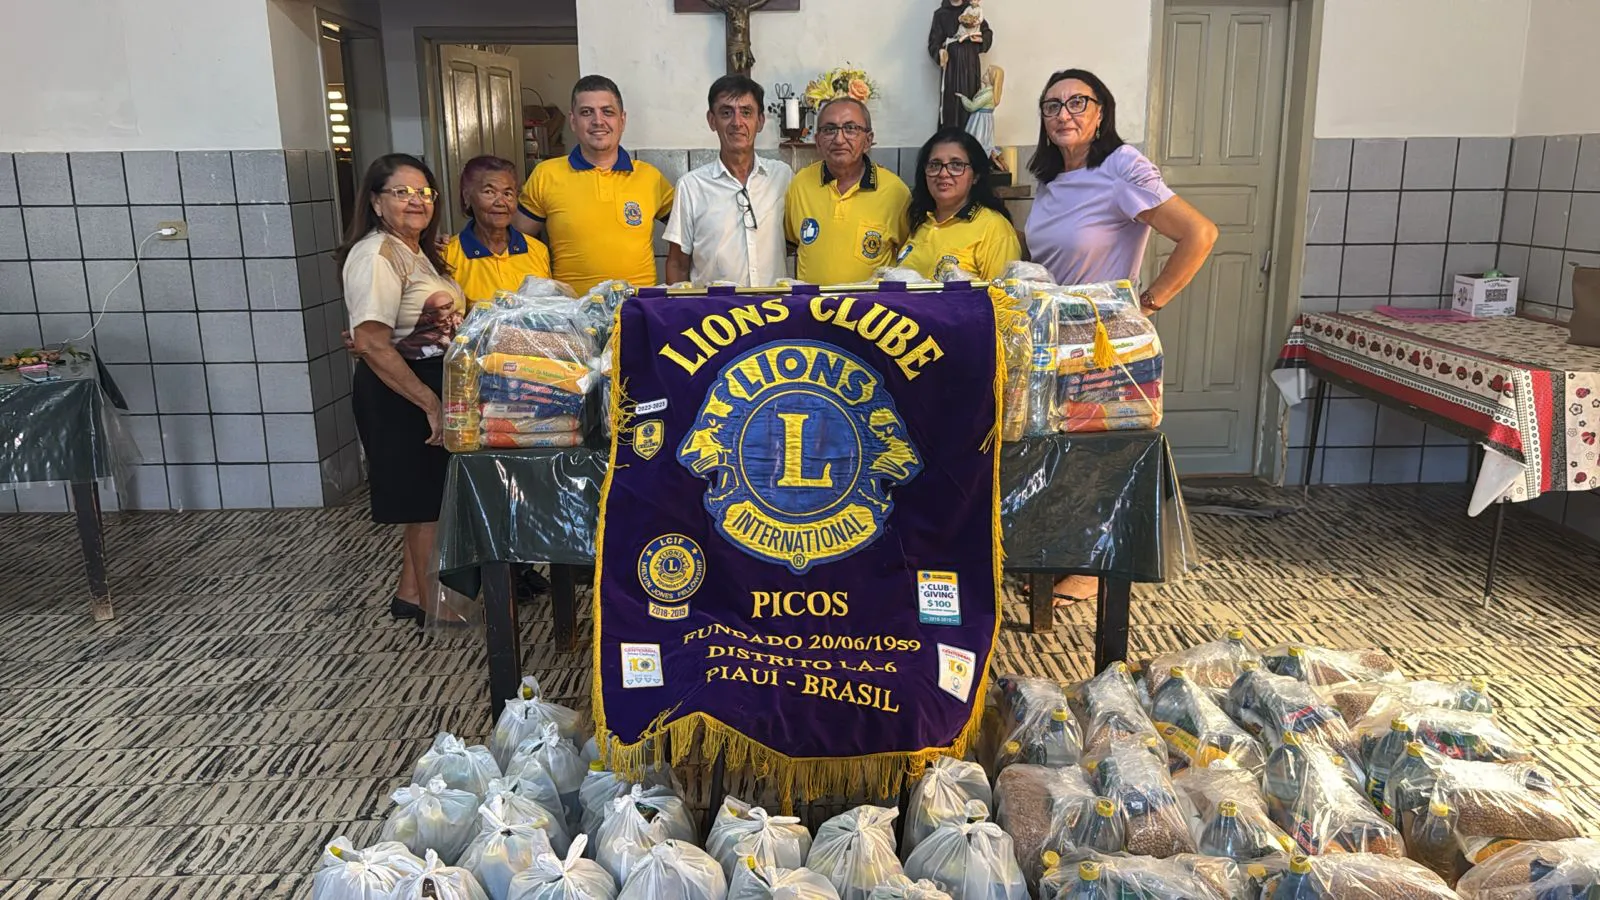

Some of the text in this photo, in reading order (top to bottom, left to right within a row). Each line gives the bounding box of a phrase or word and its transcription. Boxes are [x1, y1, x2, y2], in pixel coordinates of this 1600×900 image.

[658, 296, 945, 381] LIONS CLUBE
[731, 348, 872, 401] LIONS
[777, 413, 833, 487] L
[660, 537, 685, 546] LCIF
[731, 509, 868, 553] INTERNATIONAL
[641, 559, 703, 599] MELVIN JONES FELLOWSHIP
[668, 559, 678, 571] L
[923, 590, 954, 599] GIVING
[927, 583, 950, 591] CLUB
[652, 605, 686, 618] 2018-2019
[750, 591, 849, 618] PICOS
[683, 623, 922, 652] FUNDADO 20/06/1959
[706, 645, 898, 673] DISTRITO LA-6
[802, 674, 900, 713] BRASIL
